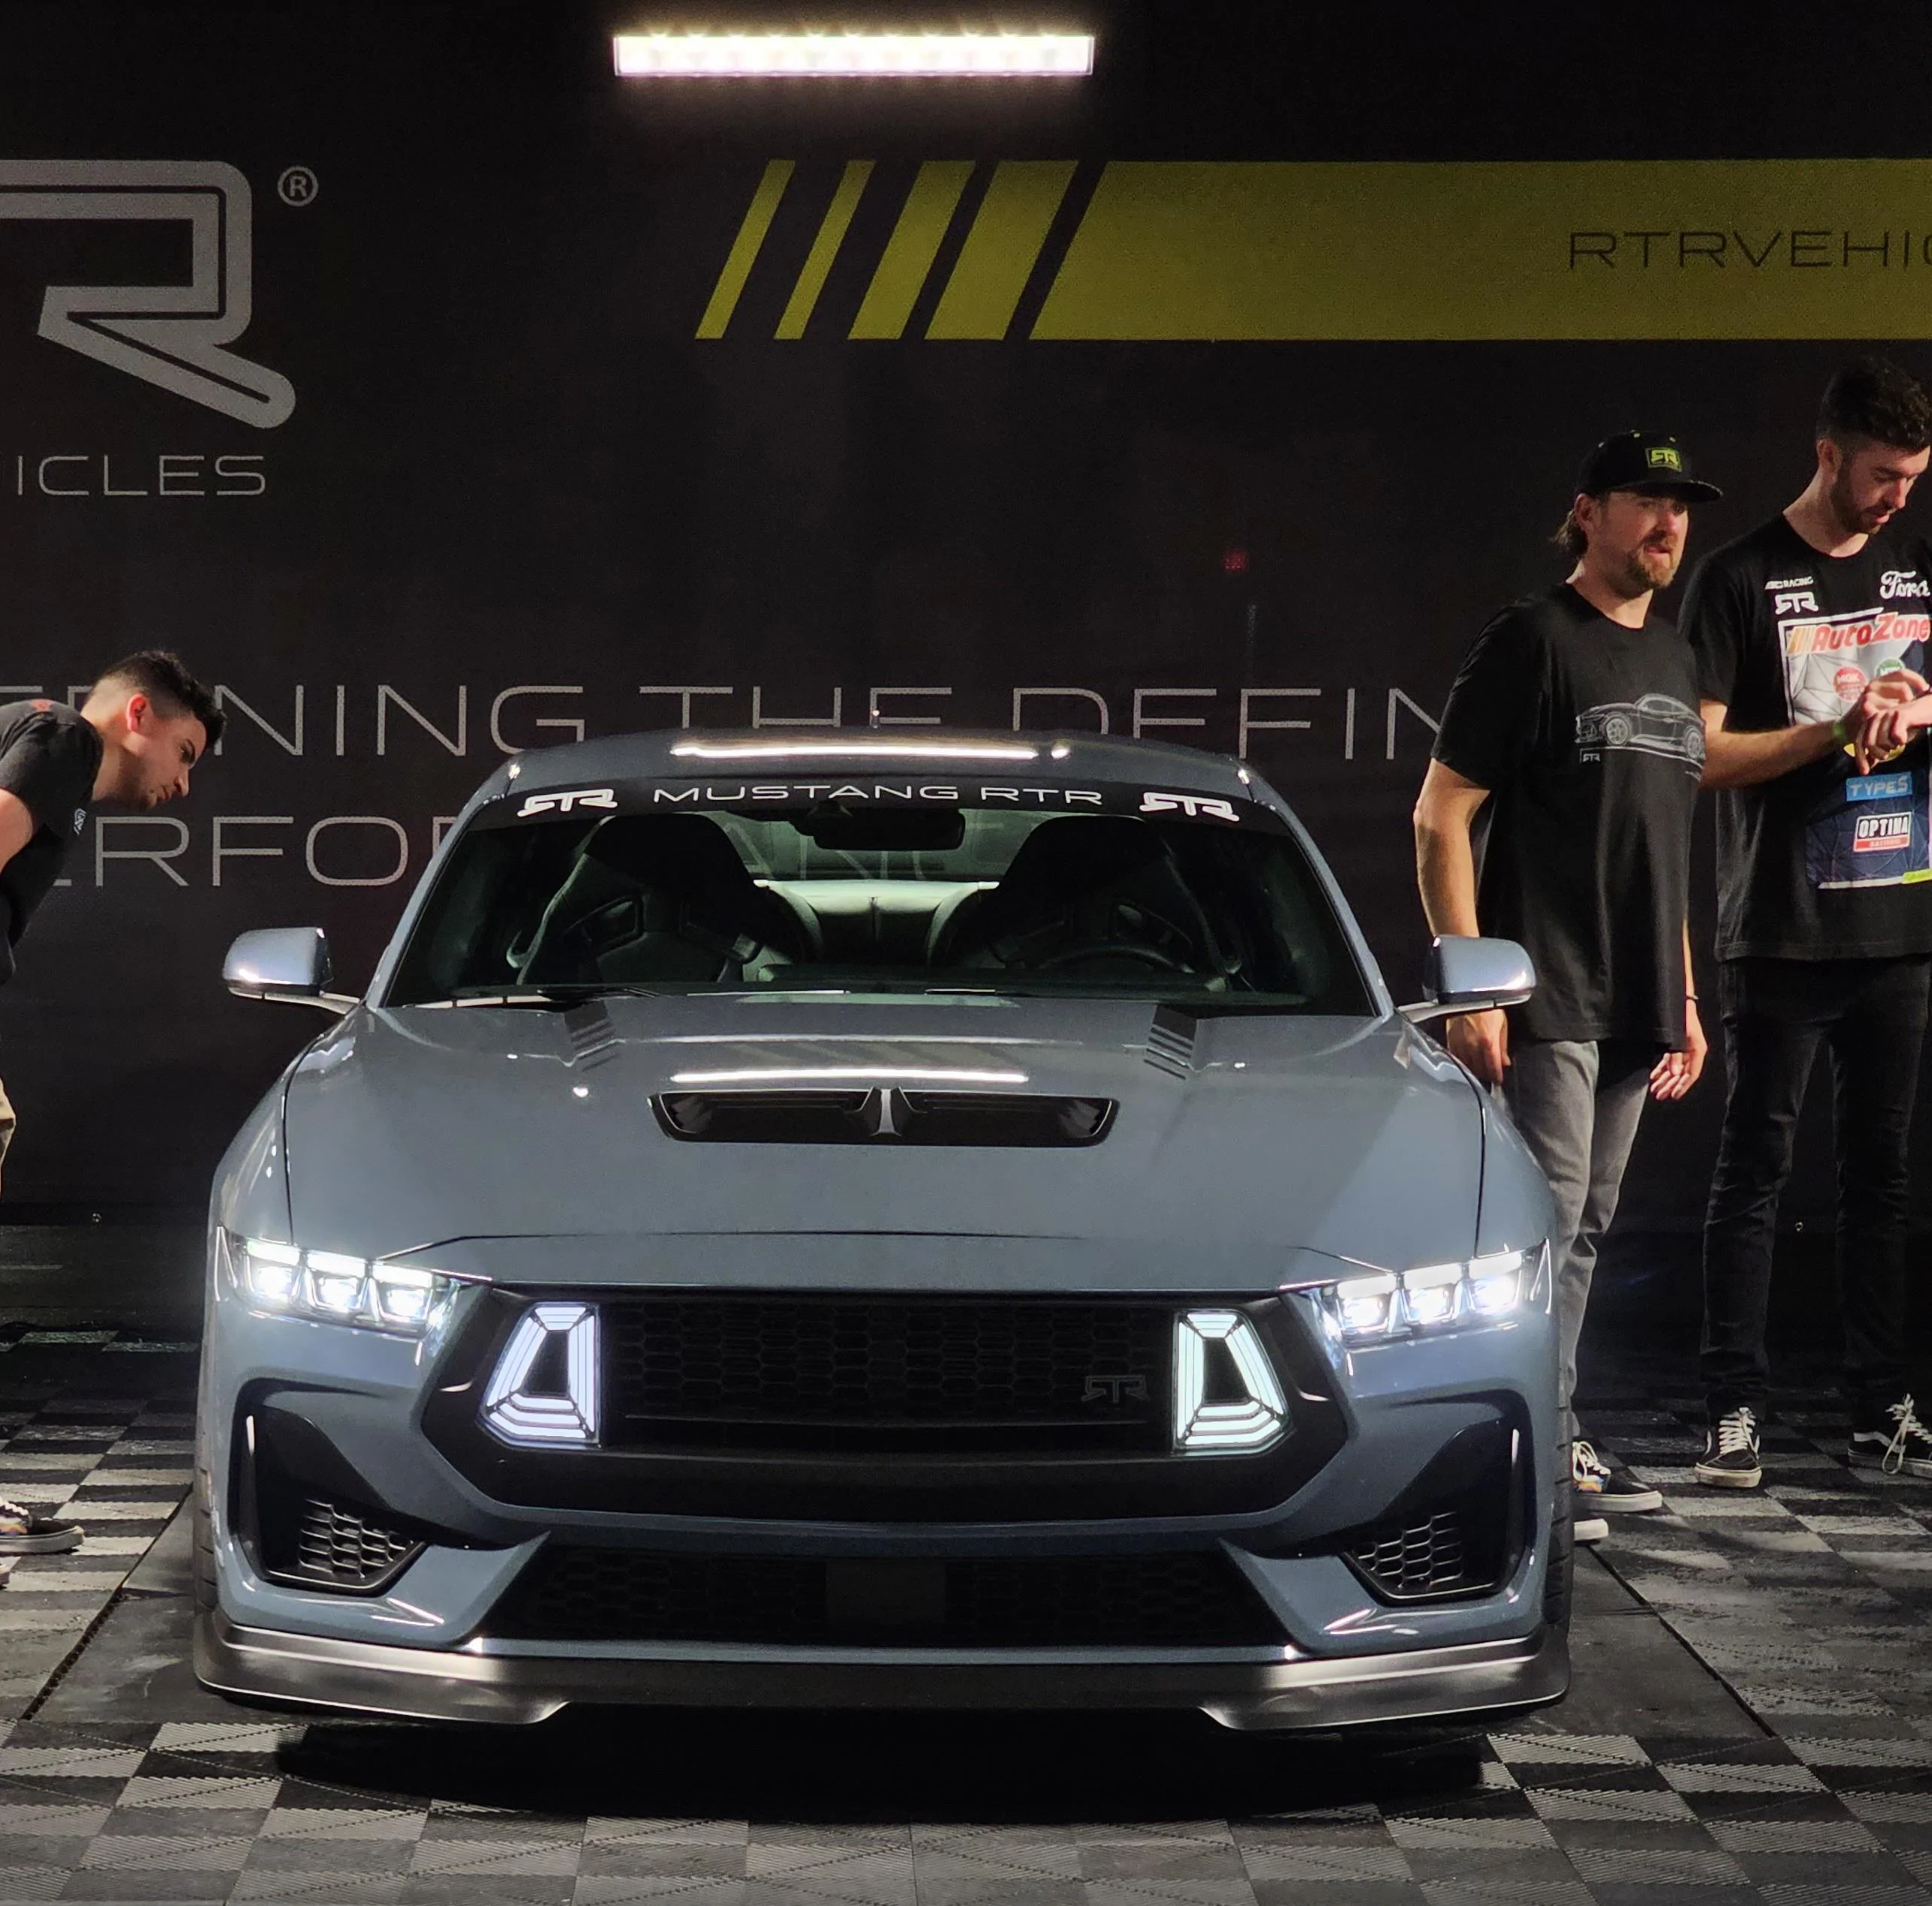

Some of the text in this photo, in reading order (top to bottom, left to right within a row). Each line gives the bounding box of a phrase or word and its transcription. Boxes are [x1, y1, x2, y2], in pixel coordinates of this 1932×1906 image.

[1570, 231, 1932, 269] RTRVEHI
[17, 455, 266, 496] ICLES
[1880, 571, 1931, 599] Ford
[1811, 612, 1931, 653] AutoZone
[640, 686, 952, 729] THE
[654, 785, 958, 804] MUSTANG
[981, 786, 1102, 805] RTR
